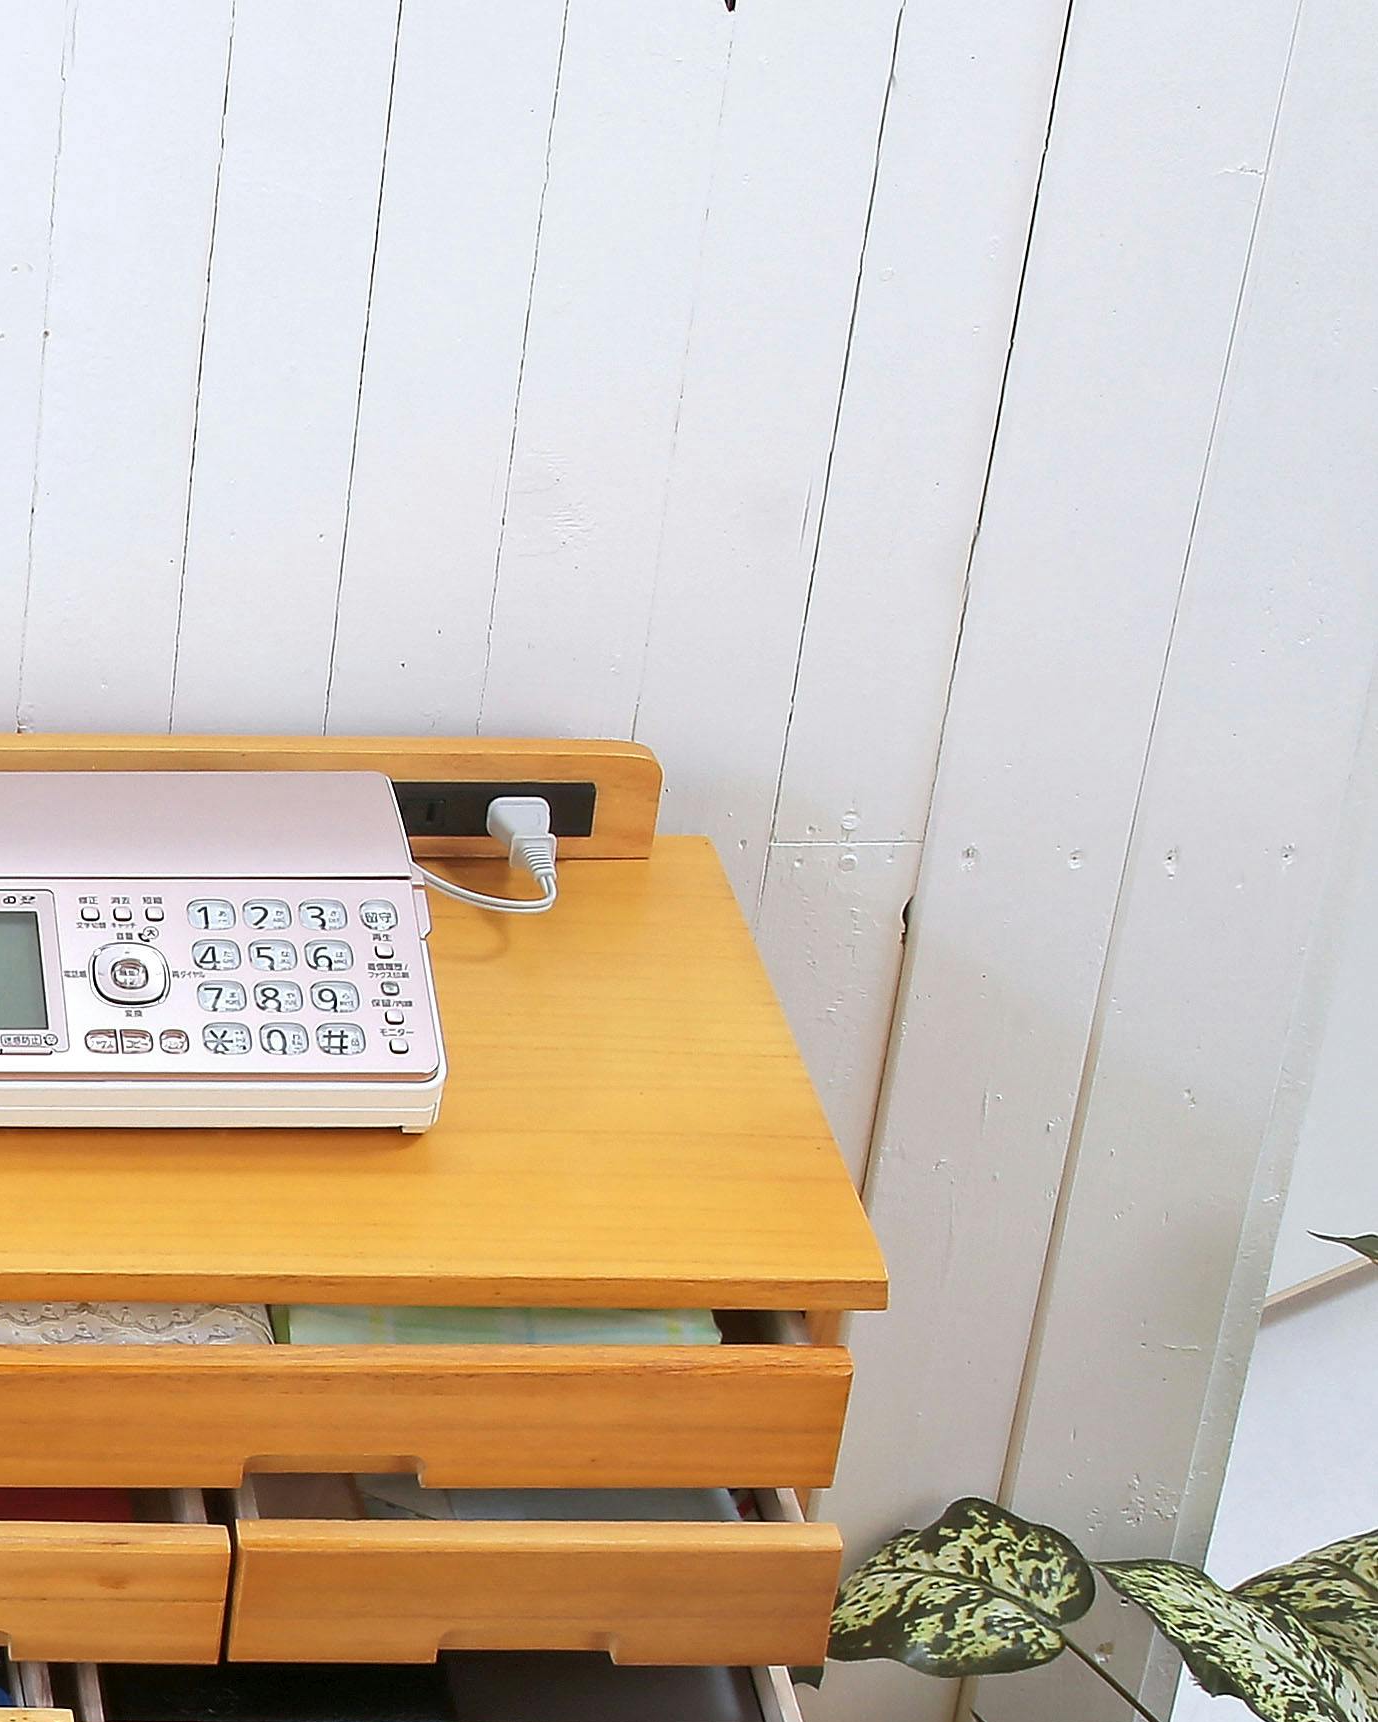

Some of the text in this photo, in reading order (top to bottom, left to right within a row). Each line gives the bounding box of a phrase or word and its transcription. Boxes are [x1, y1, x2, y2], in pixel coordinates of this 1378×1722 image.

[197, 906, 209, 930] 1
[250, 906, 269, 930] 2
[306, 906, 327, 931] 3
[199, 946, 220, 970] 4
[256, 946, 275, 971] 5
[313, 946, 333, 971] 6
[204, 987, 223, 1011] 7
[261, 987, 281, 1012] 8
[318, 988, 338, 1012] 9
[380, 1028, 414, 1037] モニター
